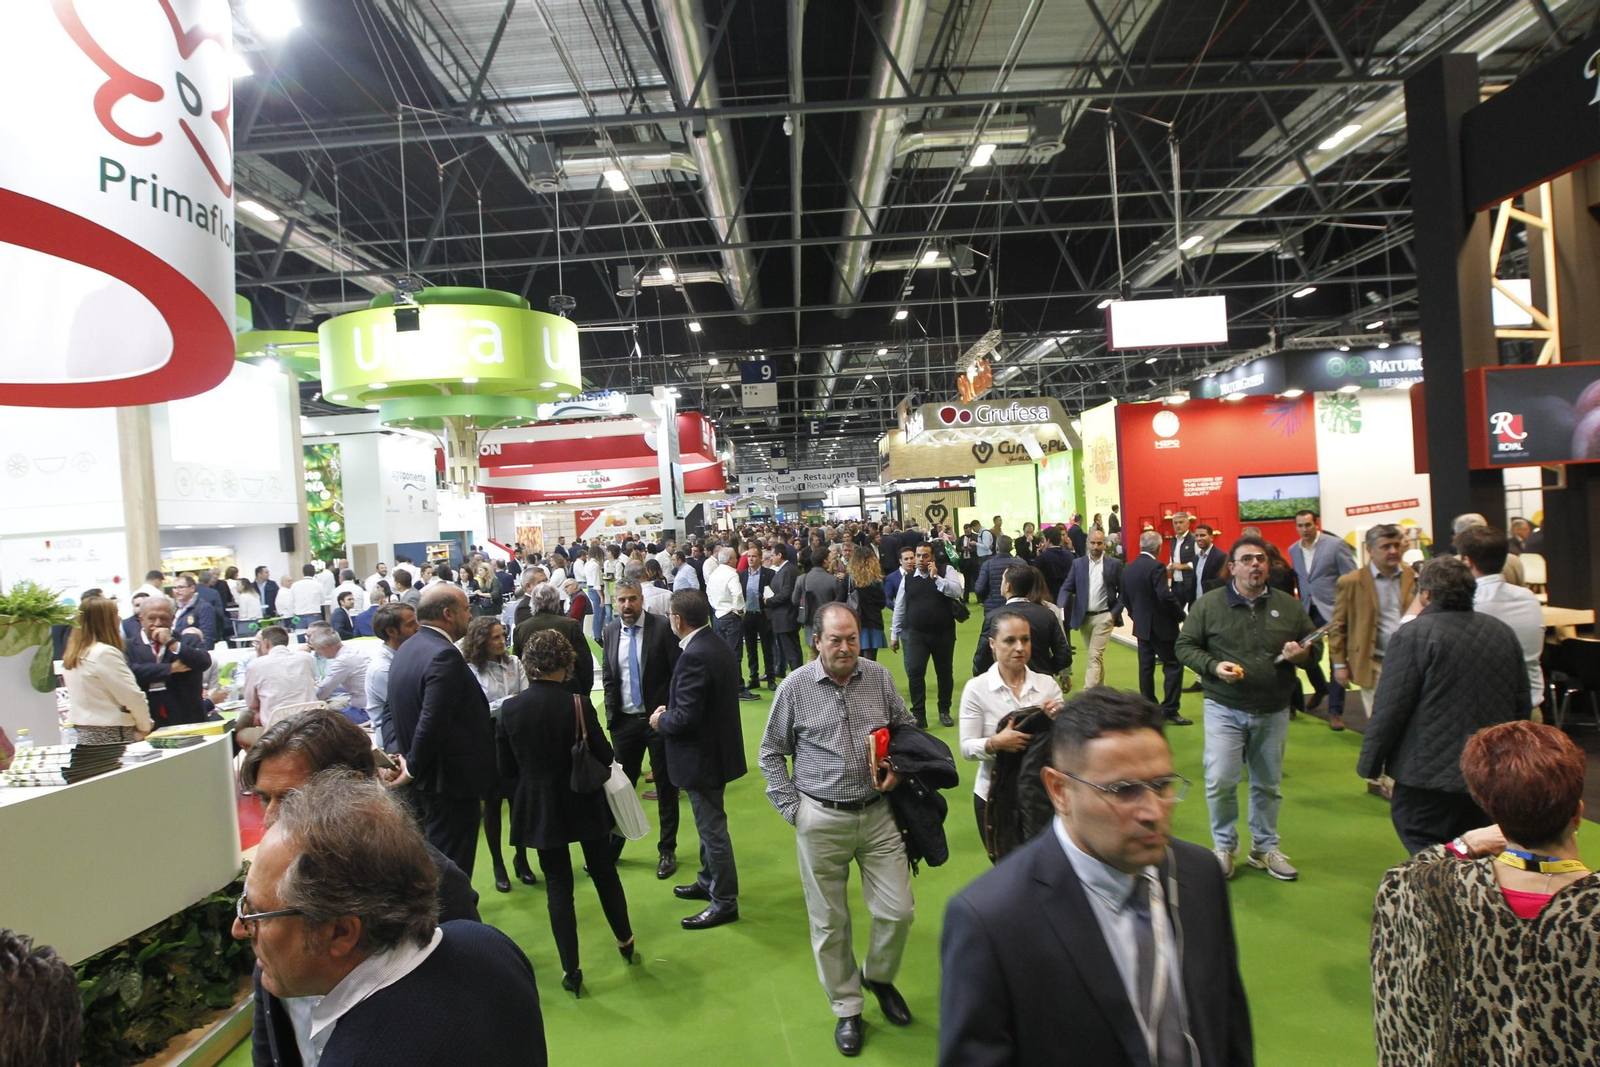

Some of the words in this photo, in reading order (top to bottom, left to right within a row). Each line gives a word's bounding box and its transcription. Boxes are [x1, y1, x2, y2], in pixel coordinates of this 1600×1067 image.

[761, 365, 772, 380] 9
[976, 402, 1049, 423] Grufesa
[810, 421, 819, 434] E
[757, 473, 796, 483] Cafeta
[803, 471, 855, 481] Restaurante
